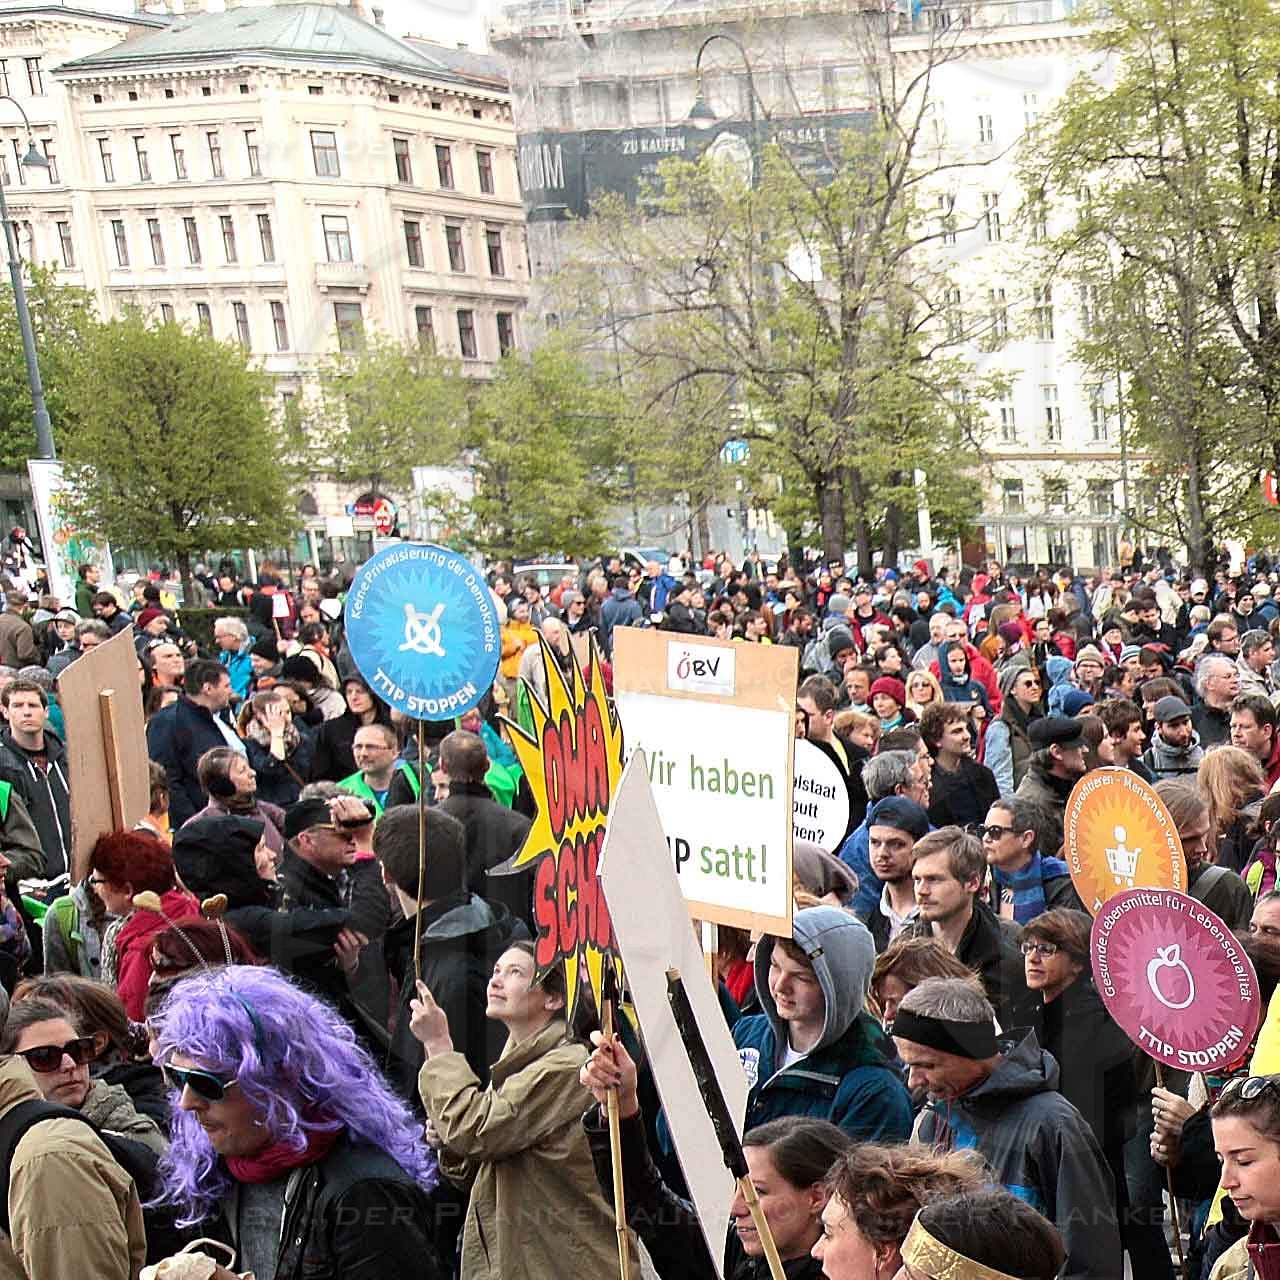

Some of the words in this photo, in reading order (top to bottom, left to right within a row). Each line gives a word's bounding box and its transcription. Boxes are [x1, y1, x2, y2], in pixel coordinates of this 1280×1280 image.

[622, 139, 638, 154] ZU
[351, 582, 369, 620] Keine
[366, 549, 447, 584] Privatisierung
[448, 559, 467, 577] der
[464, 573, 497, 653] Demokratie
[676, 650, 721, 679] ÖBV
[373, 667, 405, 701] TTIP
[407, 682, 478, 715] STOPPEN
[690, 753, 775, 800] haben
[1069, 811, 1083, 875] Konzerne
[1123, 776, 1169, 827] Menschen
[699, 843, 768, 884] satt!
[1098, 893, 1164, 938] Lebensmittel
[1166, 895, 1187, 914] für
[1096, 930, 1116, 998] Gesunde
[1188, 905, 1252, 1003] Lebensqualität
[1137, 1024, 1175, 1058] TTIP
[1177, 1024, 1245, 1068] STOPPEN
